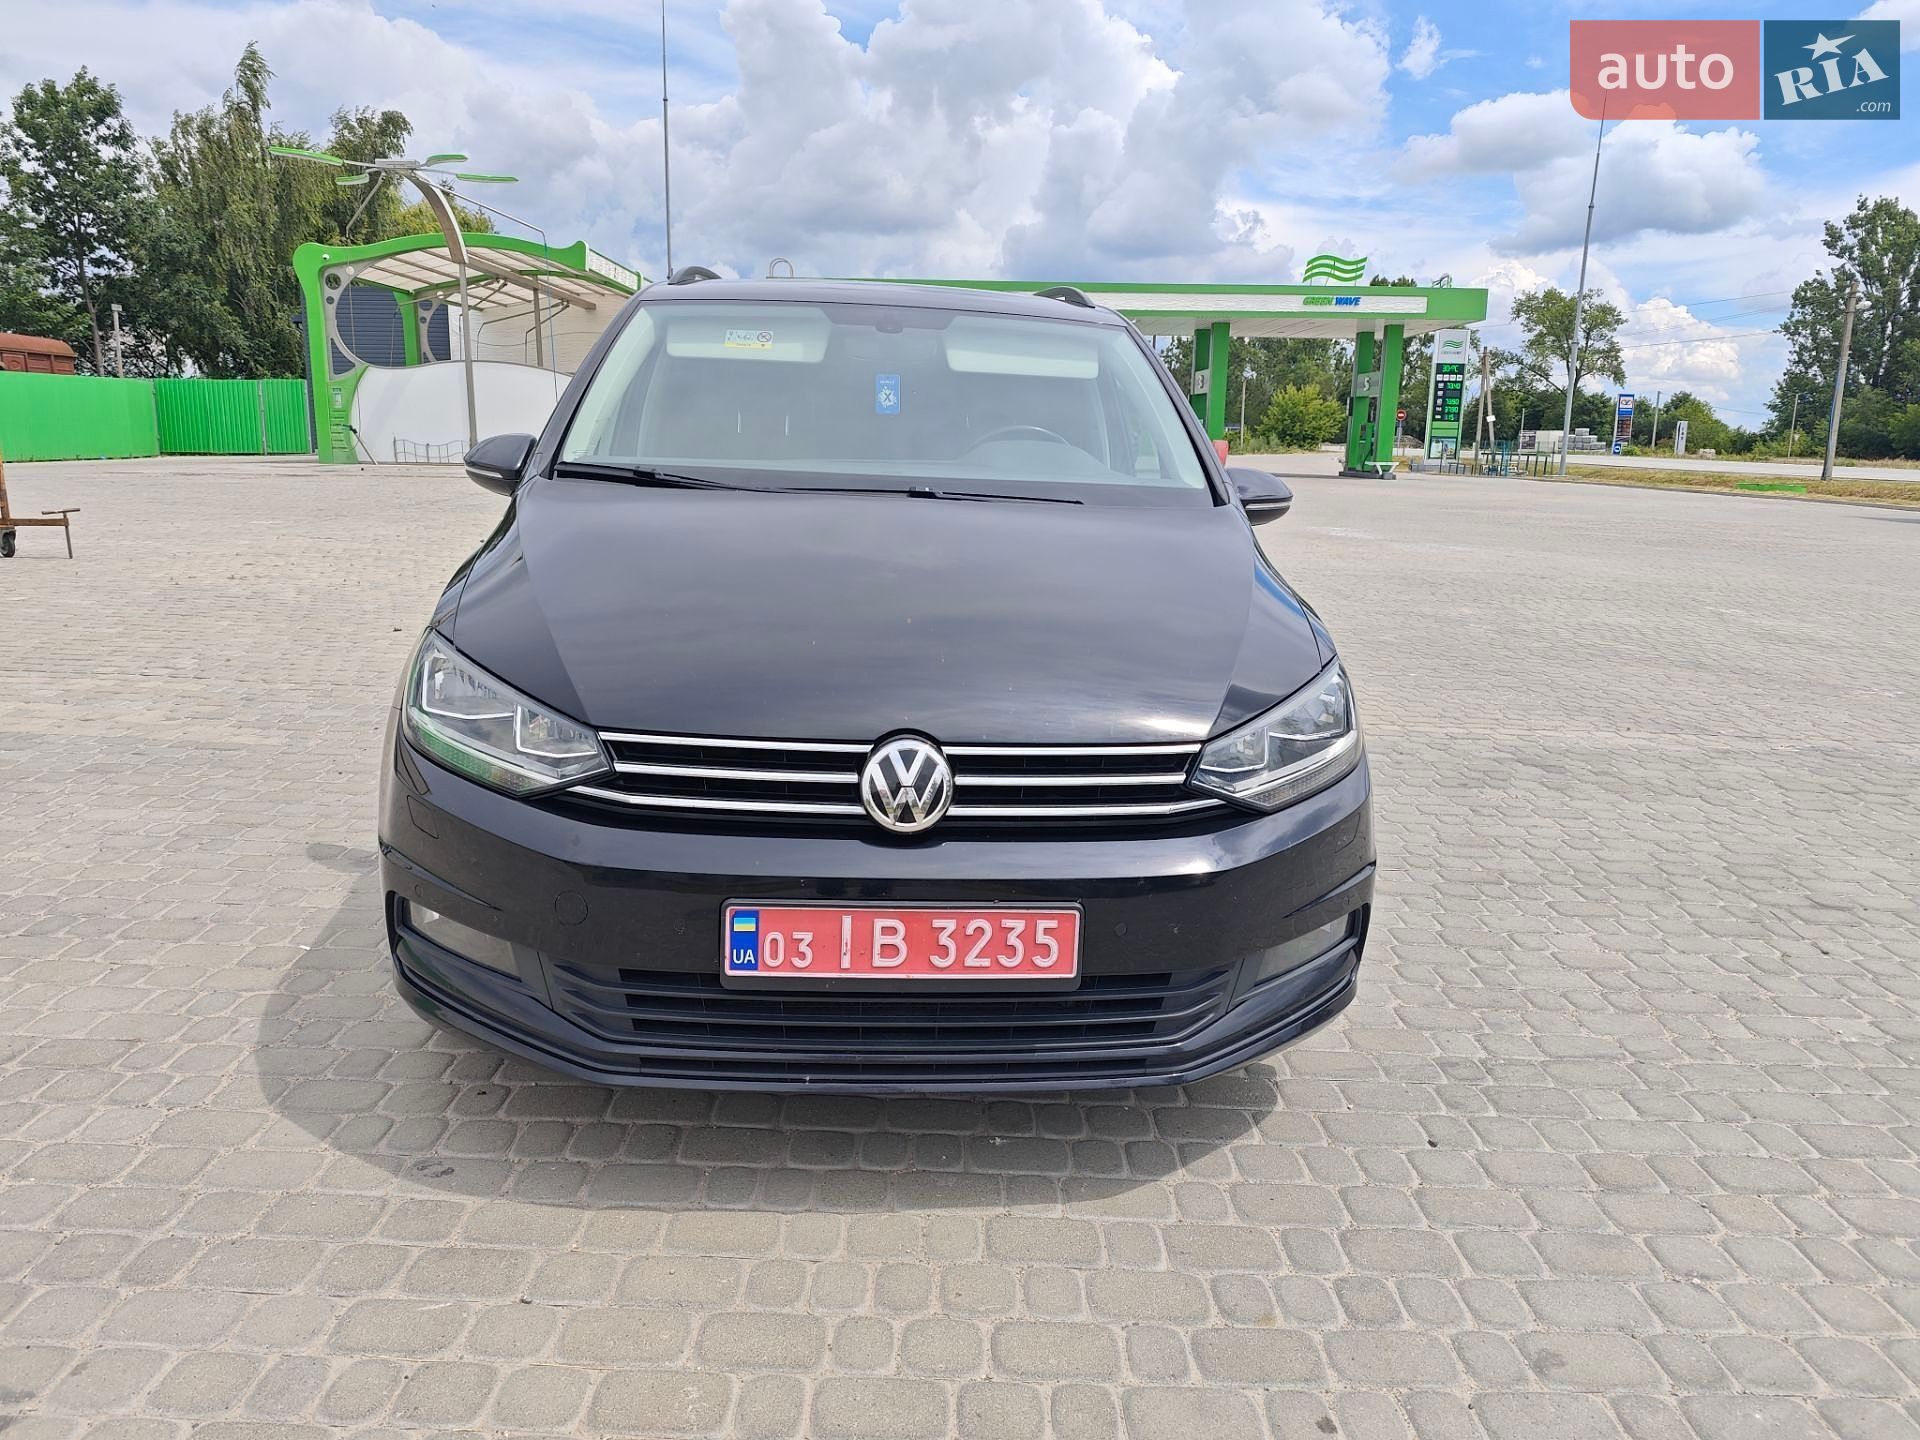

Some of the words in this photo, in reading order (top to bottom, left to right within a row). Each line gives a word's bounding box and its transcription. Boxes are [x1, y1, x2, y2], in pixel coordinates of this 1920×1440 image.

[1335, 296, 1361, 306] WAVE
[763, 932, 814, 967] 03
[929, 918, 1060, 968] 3235
[733, 949, 755, 964] UA
